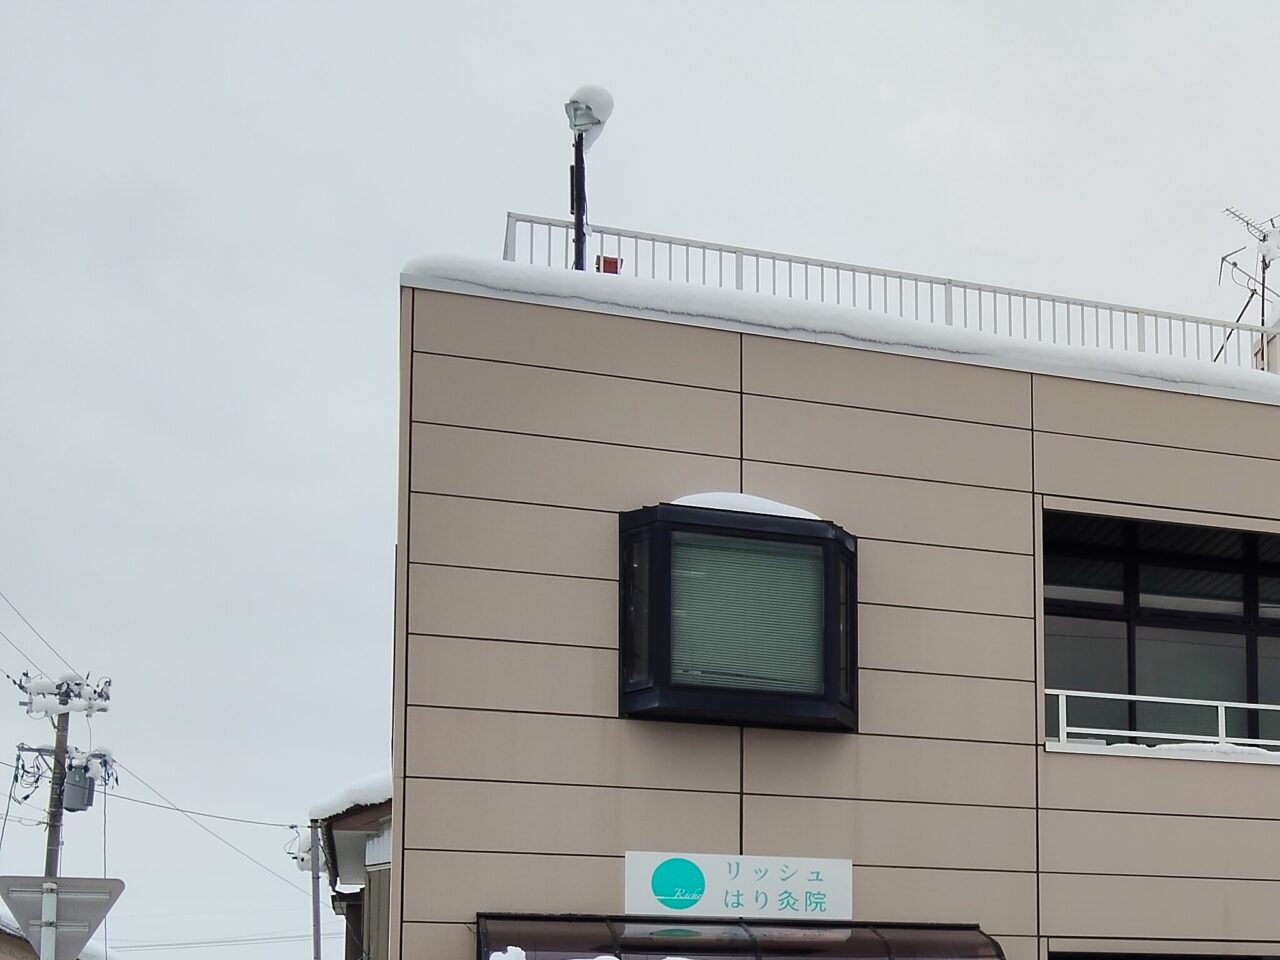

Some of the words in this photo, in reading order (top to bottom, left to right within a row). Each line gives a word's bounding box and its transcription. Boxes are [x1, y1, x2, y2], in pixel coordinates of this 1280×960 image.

[727, 861, 824, 883] リッシュ
[724, 889, 826, 913] はり灸院
